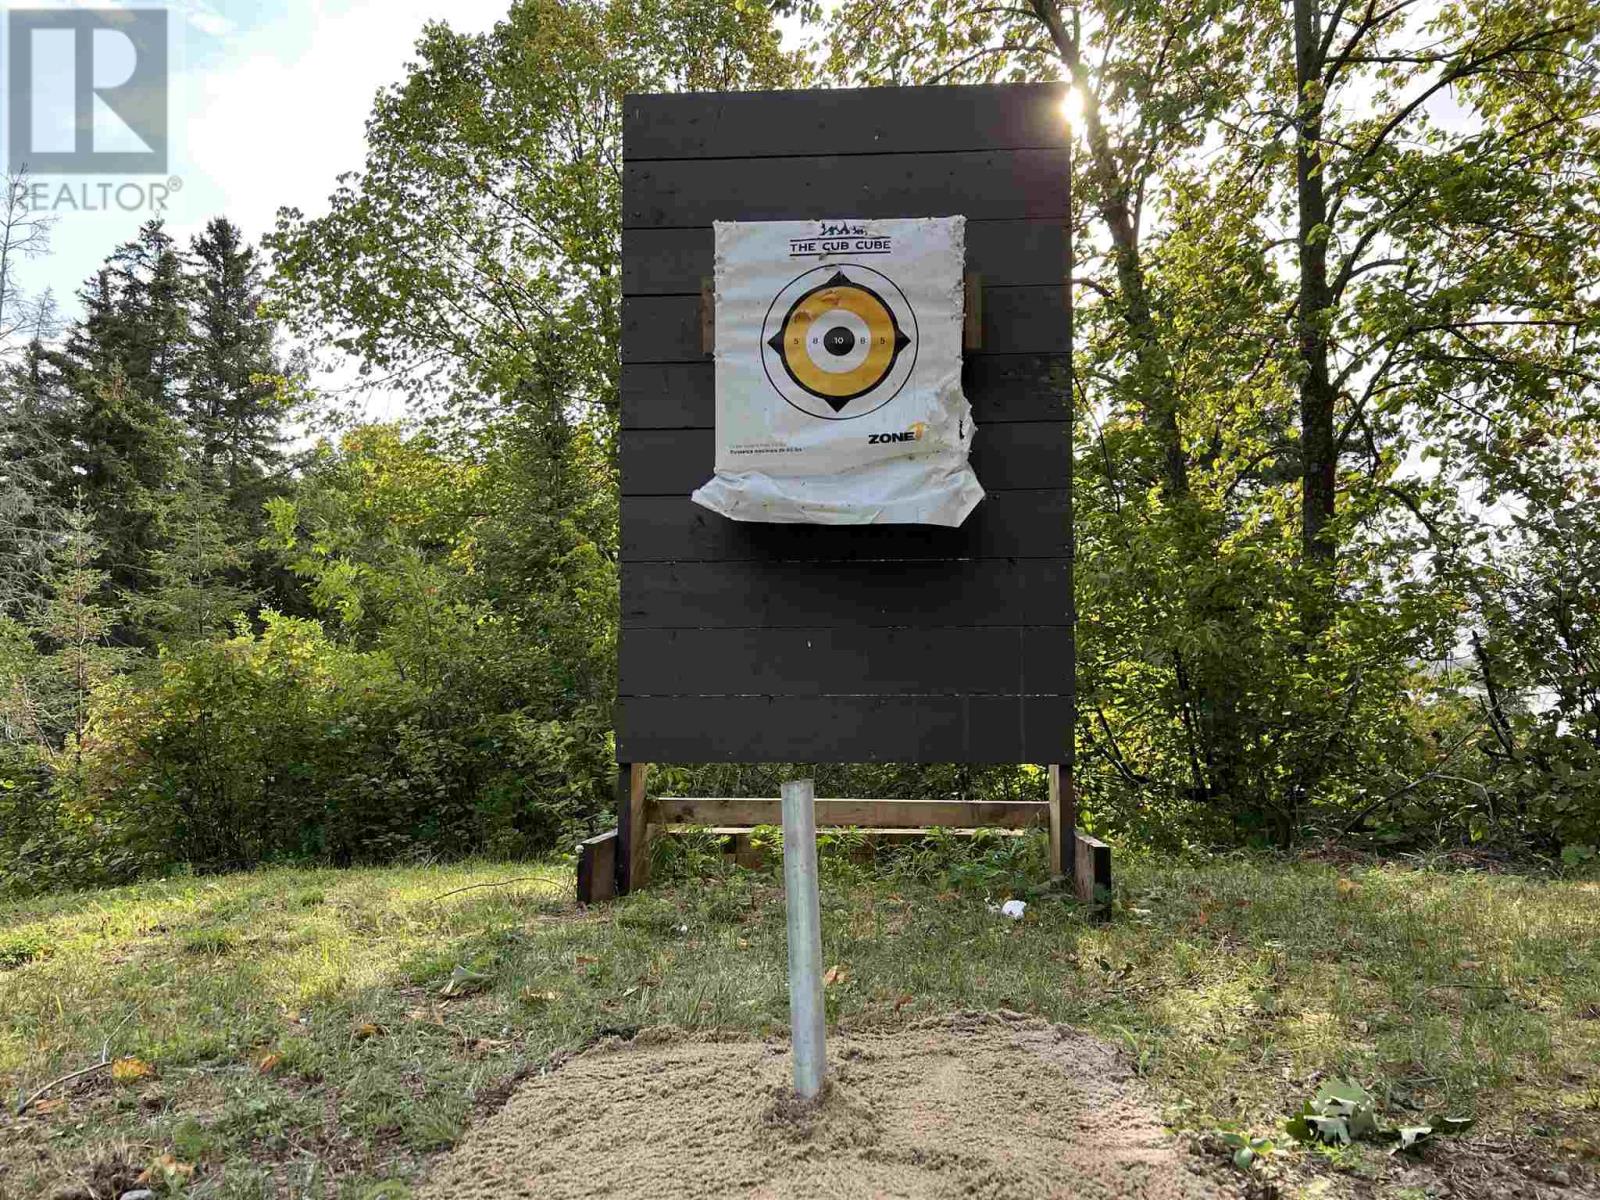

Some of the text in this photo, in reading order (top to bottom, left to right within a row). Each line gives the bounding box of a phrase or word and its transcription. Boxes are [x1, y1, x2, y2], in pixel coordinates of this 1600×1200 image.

[790, 240, 891, 251] THE CUB CUBE
